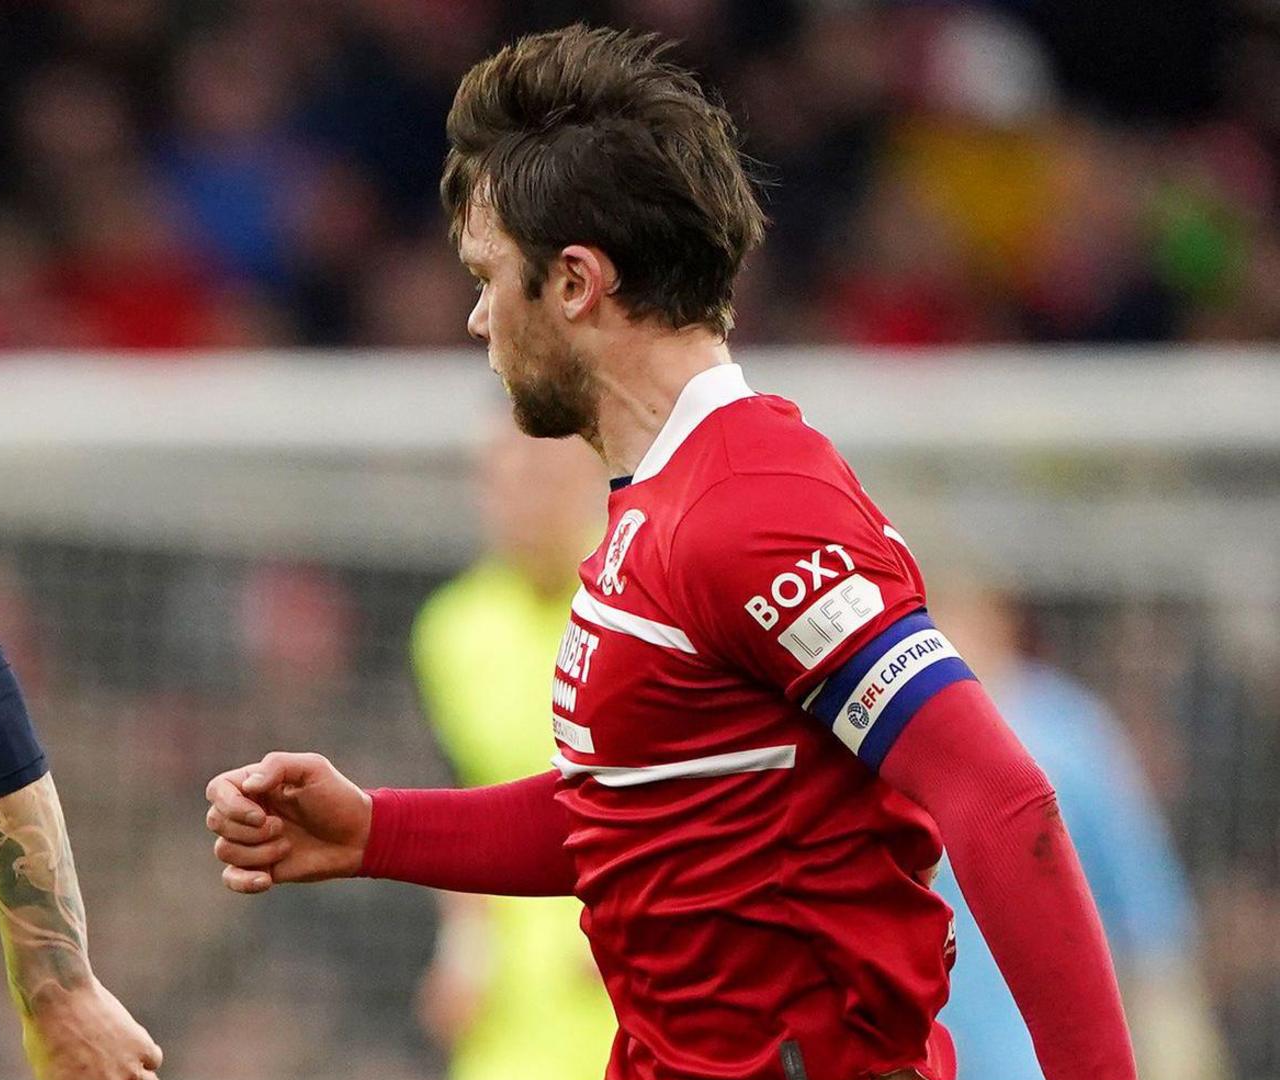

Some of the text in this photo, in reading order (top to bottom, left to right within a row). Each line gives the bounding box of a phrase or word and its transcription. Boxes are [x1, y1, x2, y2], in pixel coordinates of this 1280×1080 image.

[744, 543, 856, 632] BOXT
[790, 585, 871, 658] LIFE
[860, 637, 944, 711] EFL CAPTAIN
